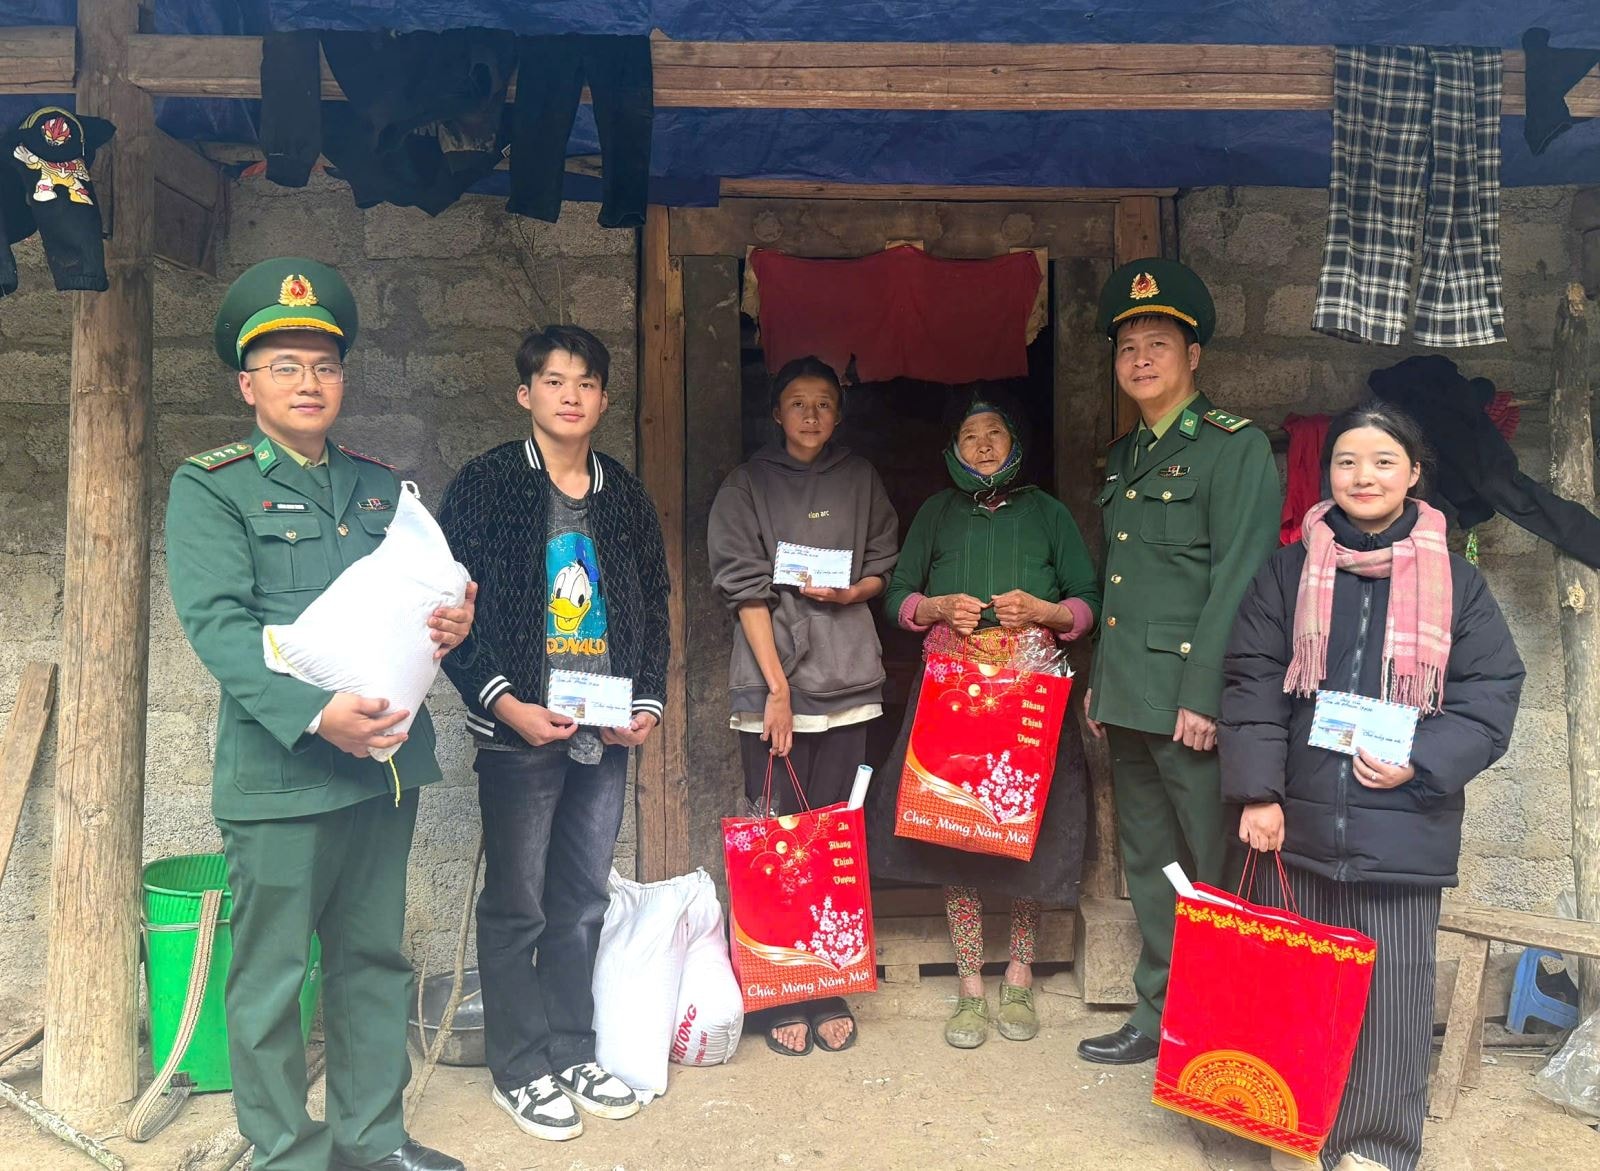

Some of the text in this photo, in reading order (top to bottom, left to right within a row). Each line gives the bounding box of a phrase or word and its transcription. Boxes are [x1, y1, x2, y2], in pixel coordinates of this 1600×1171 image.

[546, 636, 607, 656] DONALD
[902, 810, 1029, 844] Chúc Mừng Năm Mới
[747, 969, 870, 998] Chúc Mừng Năm Mới
